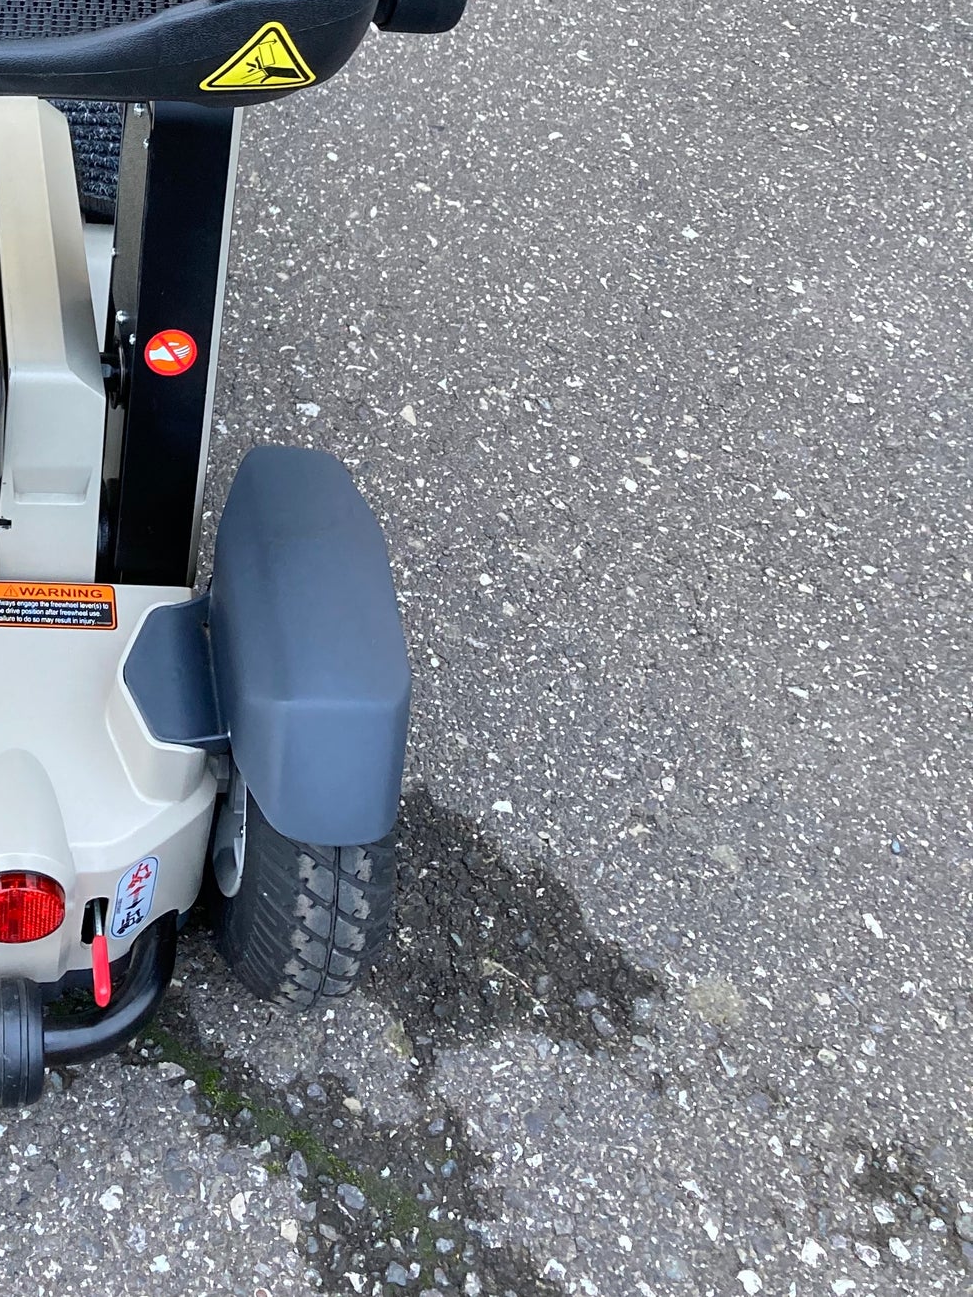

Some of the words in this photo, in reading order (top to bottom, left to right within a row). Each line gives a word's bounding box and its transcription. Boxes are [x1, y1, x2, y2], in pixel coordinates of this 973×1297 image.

[19, 586, 103, 599] WARNING
[39, 600, 49, 608] the
[50, 601, 79, 609] freewheel
[79, 602, 102, 610] lever(s)
[5, 607, 21, 615] drive
[21, 608, 45, 616] position
[60, 609, 88, 617] freewheel
[23, 615, 32, 623] do
[41, 617, 54, 625] may
[79, 618, 97, 626] injury.
